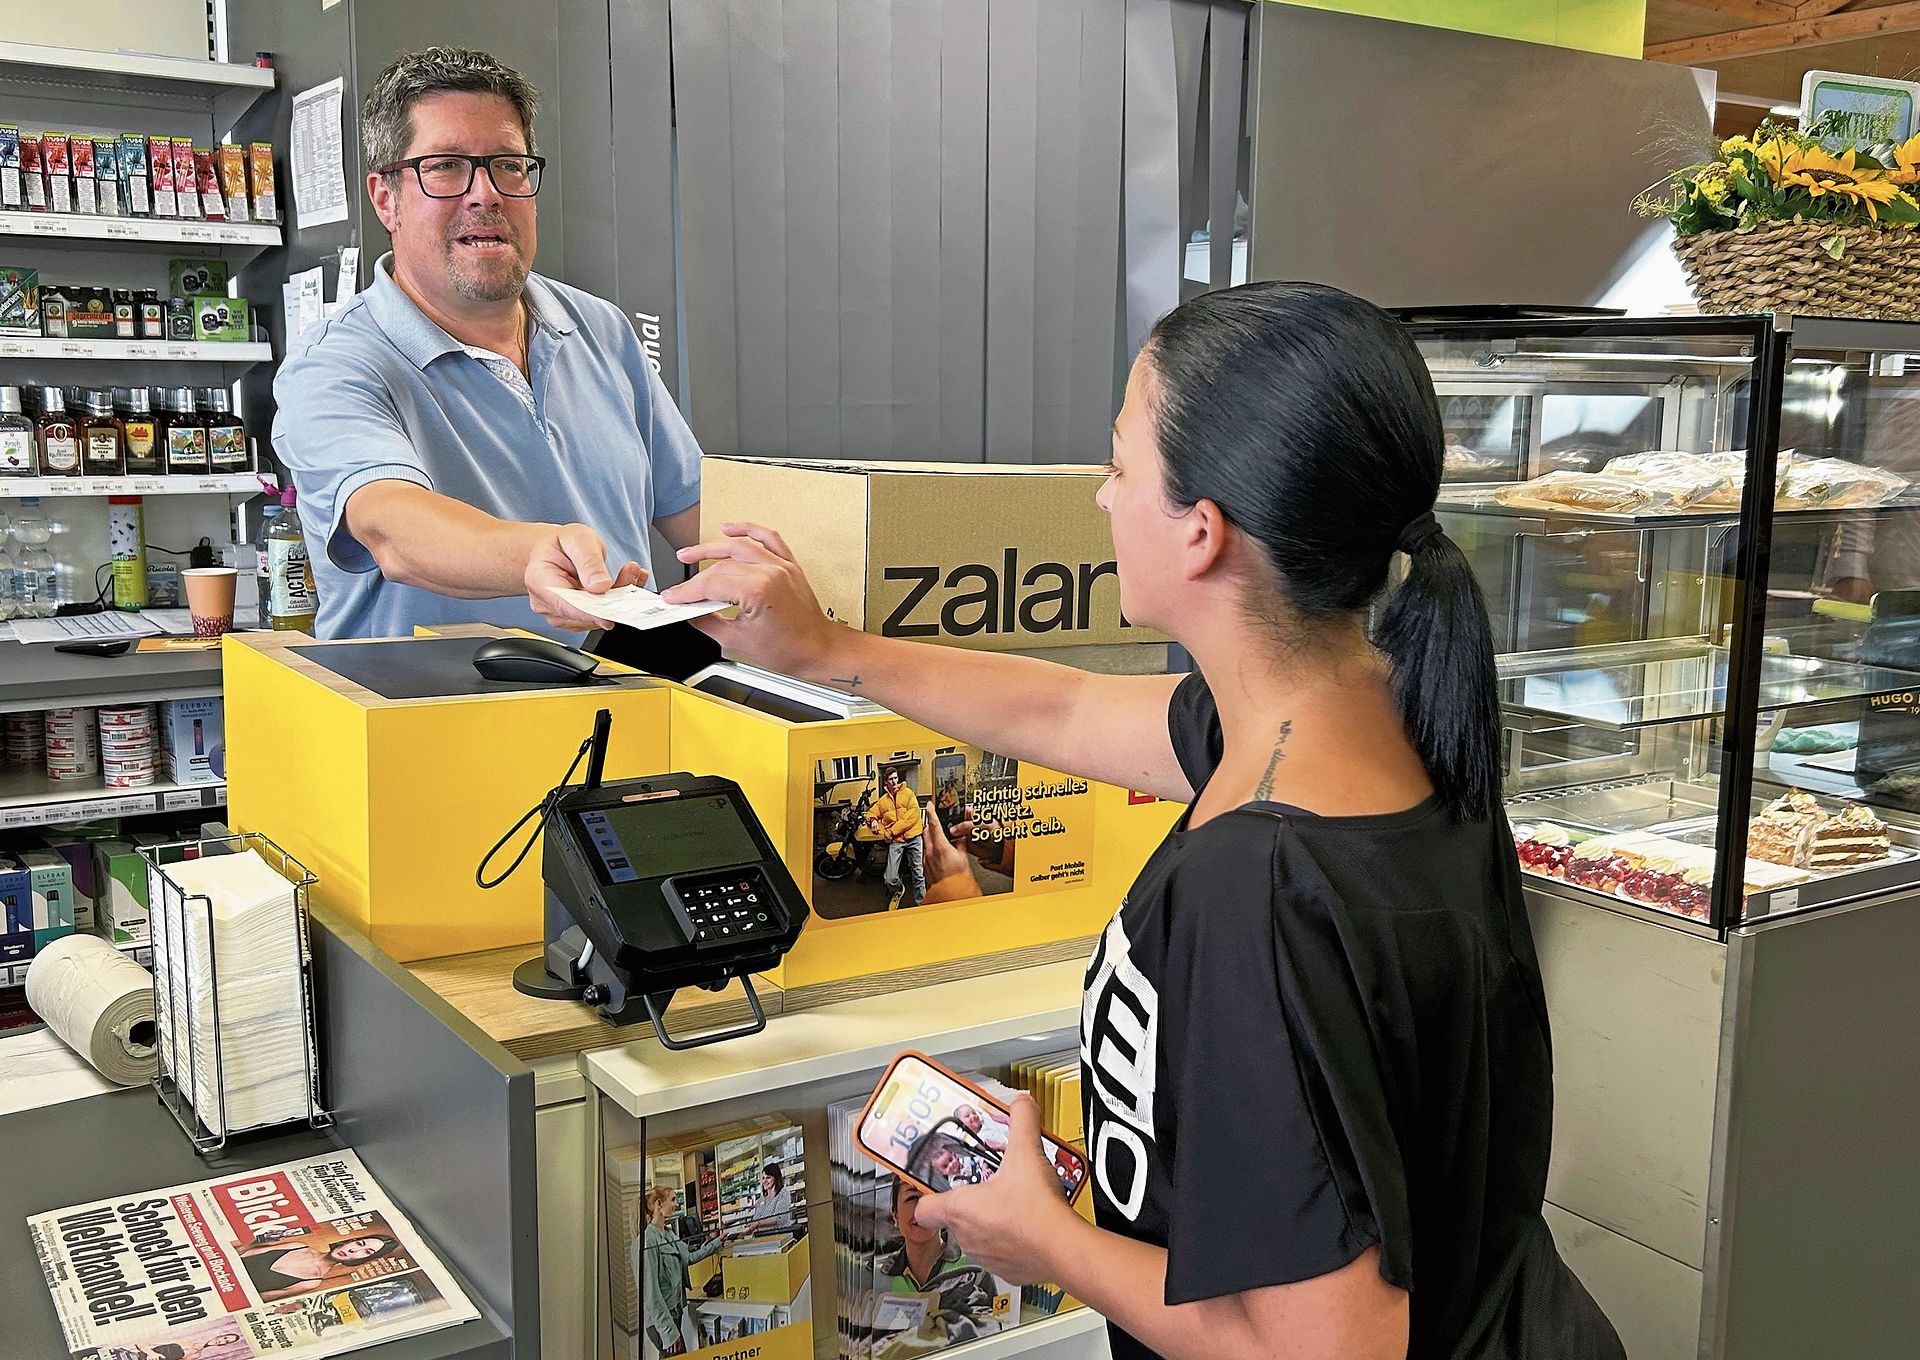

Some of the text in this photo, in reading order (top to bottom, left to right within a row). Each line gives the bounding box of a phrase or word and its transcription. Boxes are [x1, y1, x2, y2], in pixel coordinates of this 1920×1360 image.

[147, 564, 176, 572] Ricola
[1870, 692, 1914, 706] HUGO
[973, 778, 1088, 804] Richtig schnelles
[972, 817, 1066, 842] So geht Gelb.
[1050, 861, 1084, 872] Post Mobile
[1070, 869, 1084, 877] nicht
[889, 1081, 941, 1151] 15:05
[227, 1180, 299, 1237] Blick
[174, 1196, 193, 1224] Weiterem
[188, 1222, 206, 1246] Seeweg
[209, 1259, 235, 1292] Blockade
[57, 1207, 157, 1326] Welthandel!
[117, 1199, 212, 1326] Schock für den
[712, 1345, 762, 1360] Partner
